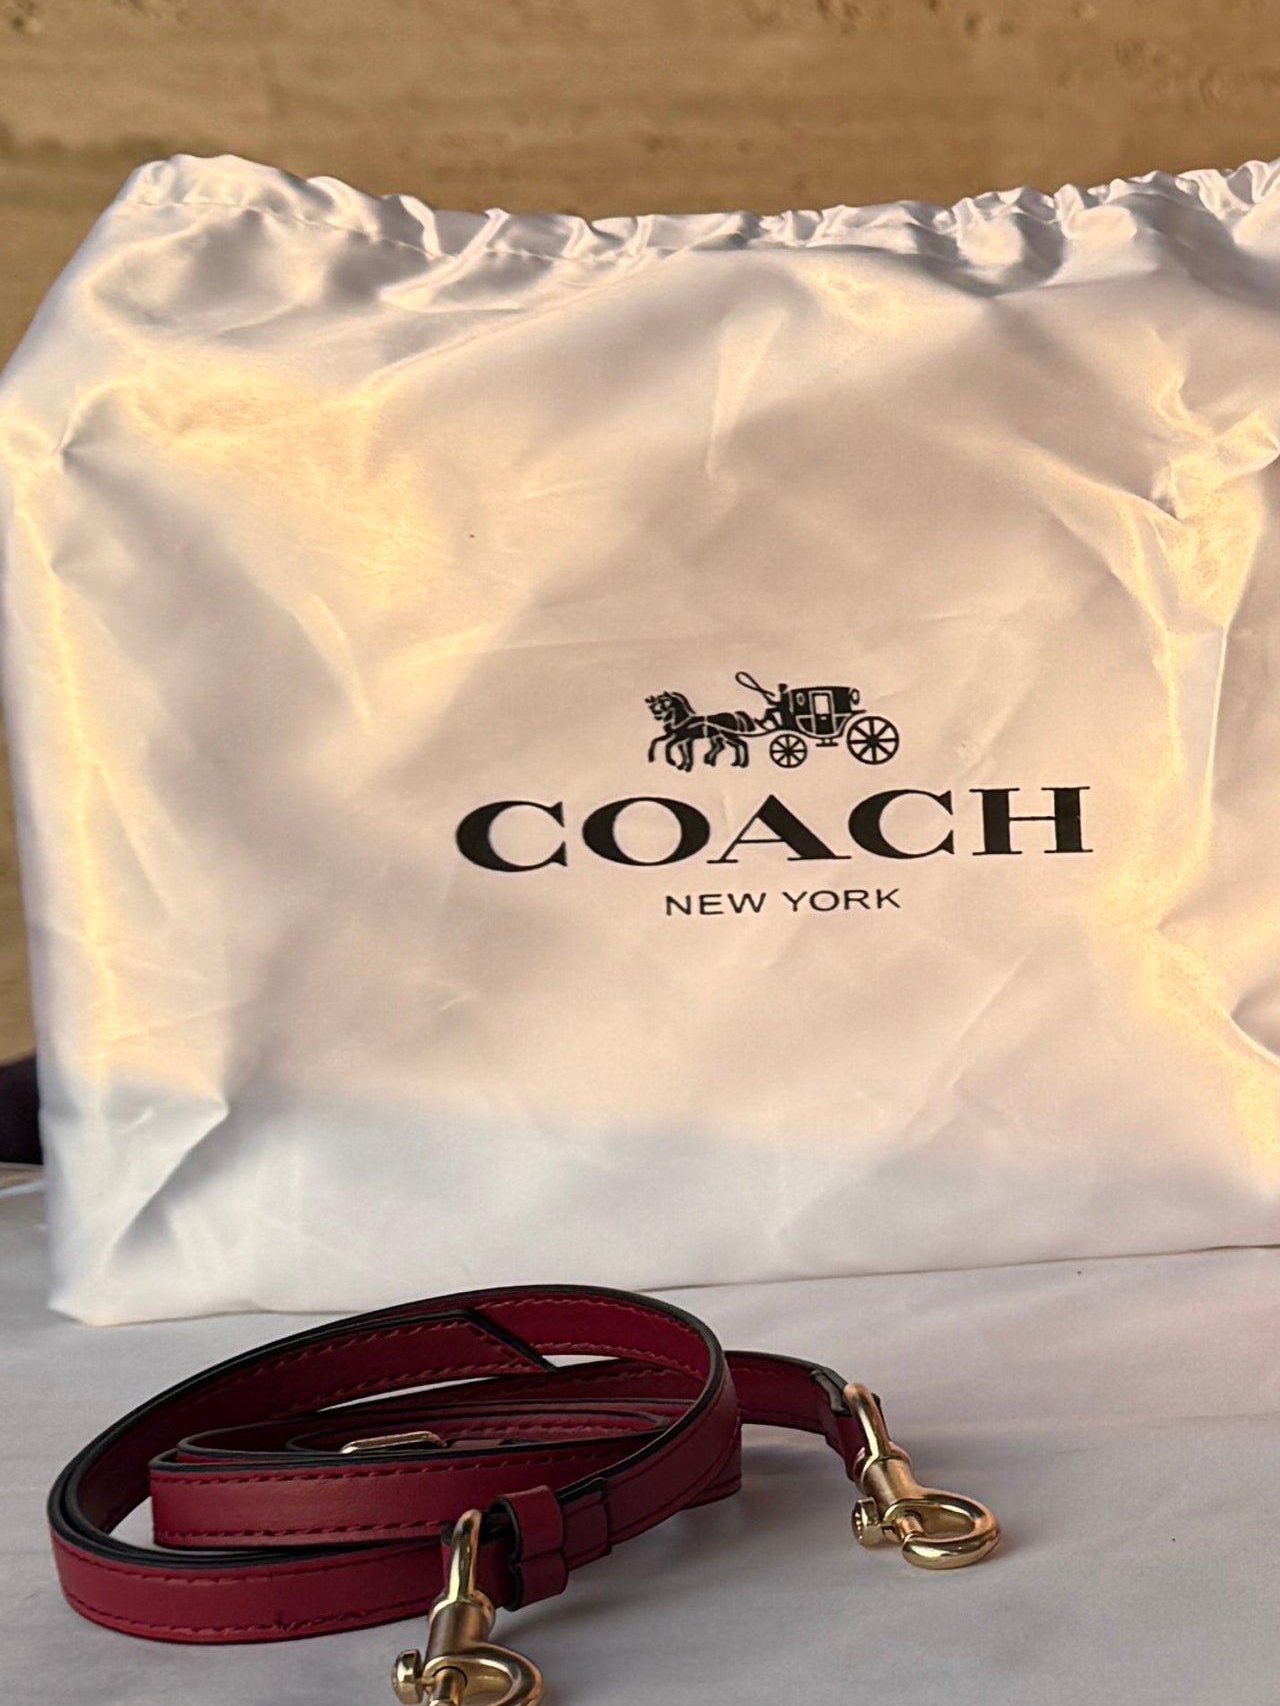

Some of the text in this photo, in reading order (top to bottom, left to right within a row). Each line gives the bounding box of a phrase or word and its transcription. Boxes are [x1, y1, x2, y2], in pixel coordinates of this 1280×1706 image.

[455, 785, 1094, 873] COACH
[665, 887, 902, 917] NEW YORK
